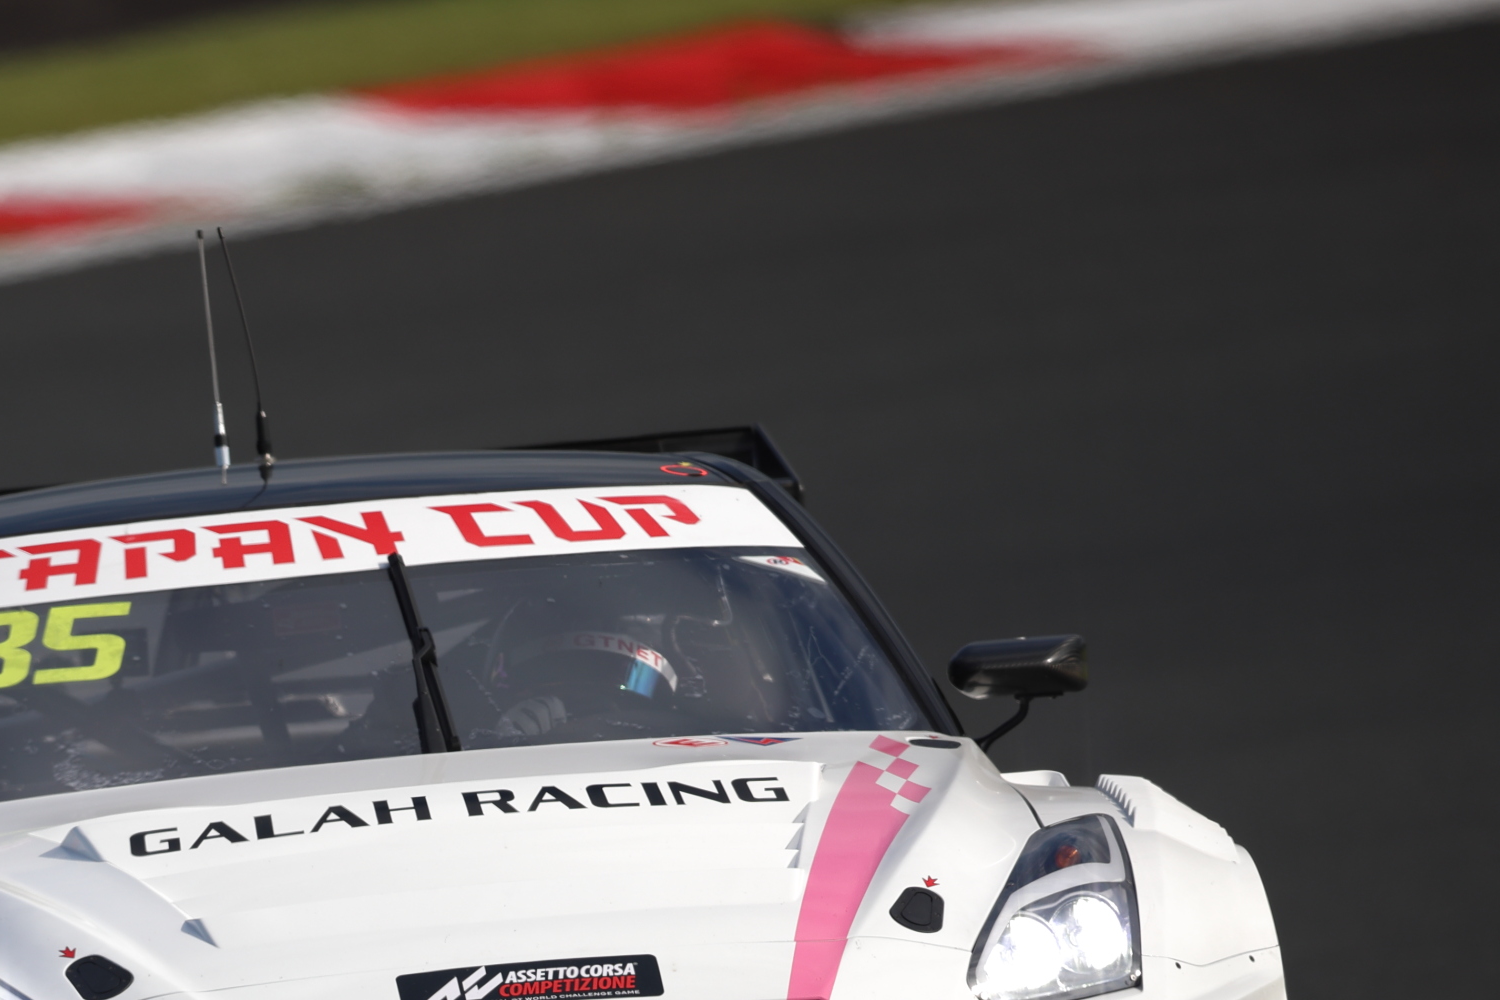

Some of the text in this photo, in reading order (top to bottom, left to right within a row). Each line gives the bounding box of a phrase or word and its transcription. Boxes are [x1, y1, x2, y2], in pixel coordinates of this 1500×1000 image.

[428, 494, 701, 549] CUP
[573, 633, 663, 668] GTNET
[128, 776, 790, 857] GALAH RACING
[498, 975, 637, 998] COMPETIZIONE
[504, 962, 636, 984] ASSETTO CORSA
[525, 993, 558, 1000] WORLD
[559, 990, 613, 999] CHALLENGE
